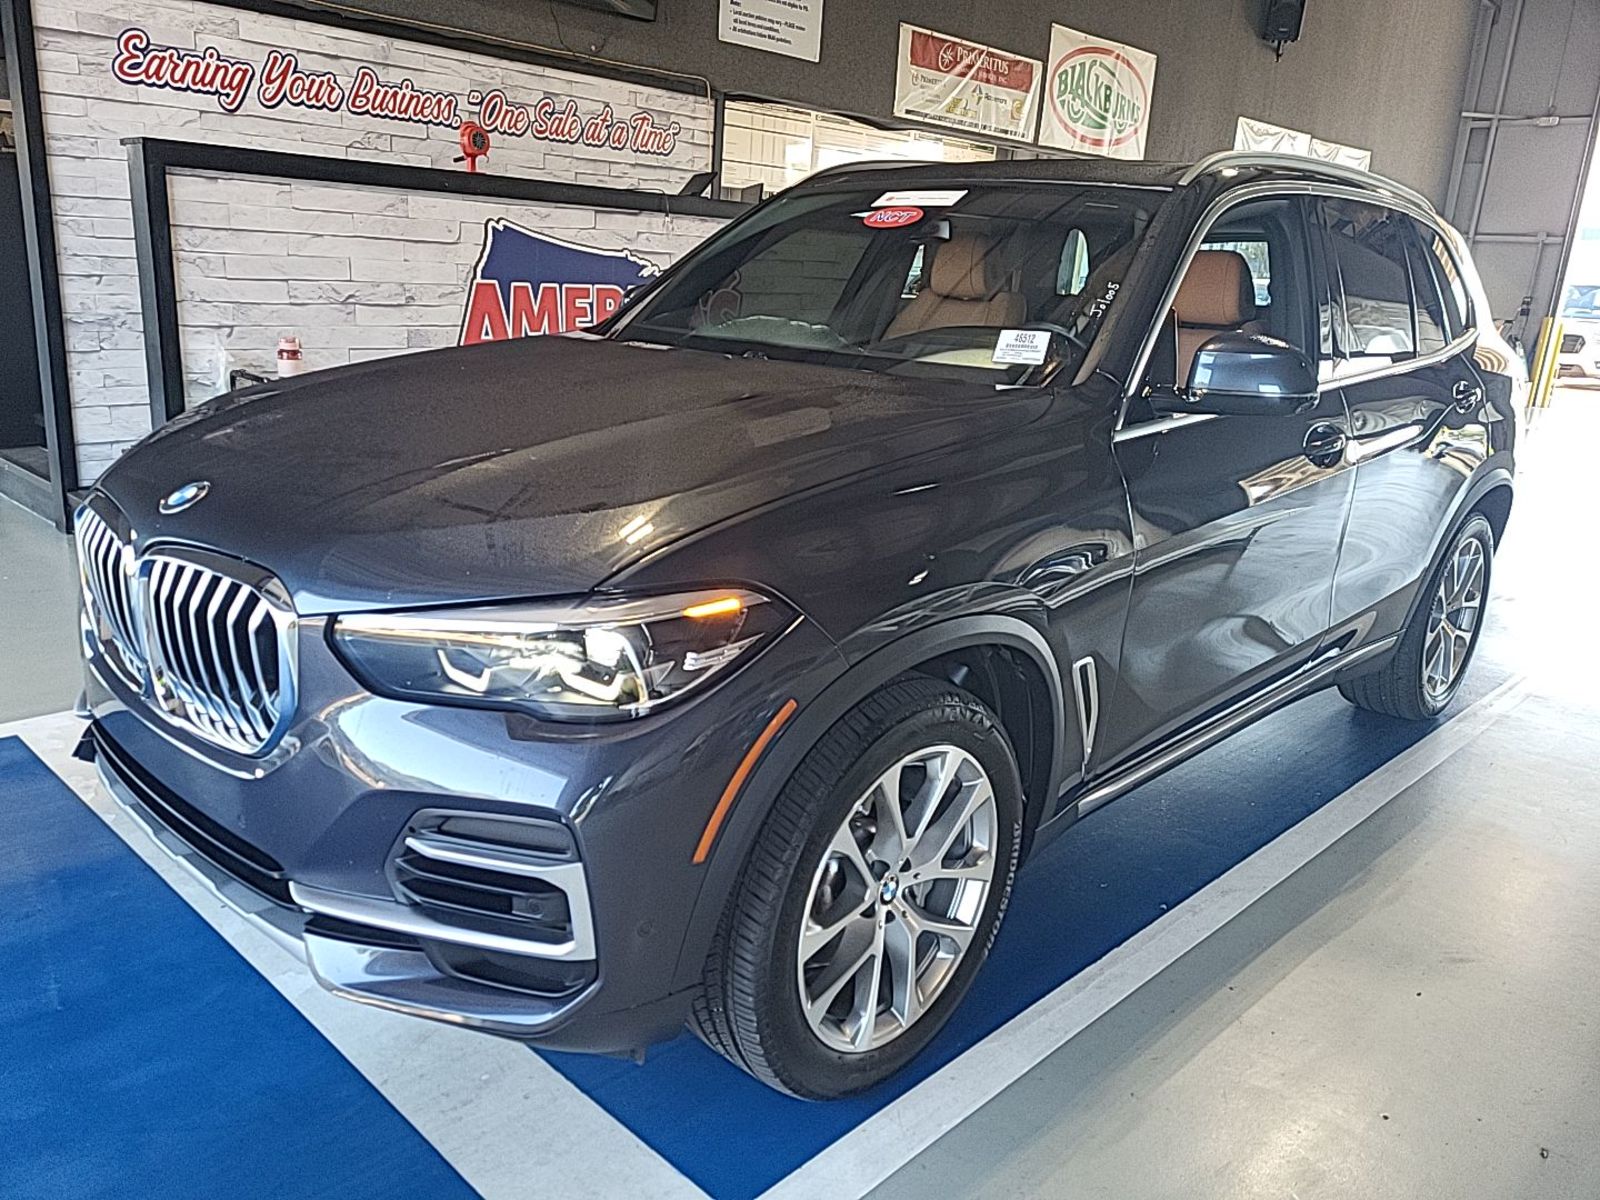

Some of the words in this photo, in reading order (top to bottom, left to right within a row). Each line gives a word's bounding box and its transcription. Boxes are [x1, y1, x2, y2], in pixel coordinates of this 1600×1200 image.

[114, 30, 253, 110] Earning
[260, 52, 343, 108] Your
[534, 100, 581, 141] Sale
[583, 106, 612, 145] at
[610, 122, 629, 149] a
[461, 280, 634, 345] AMER
